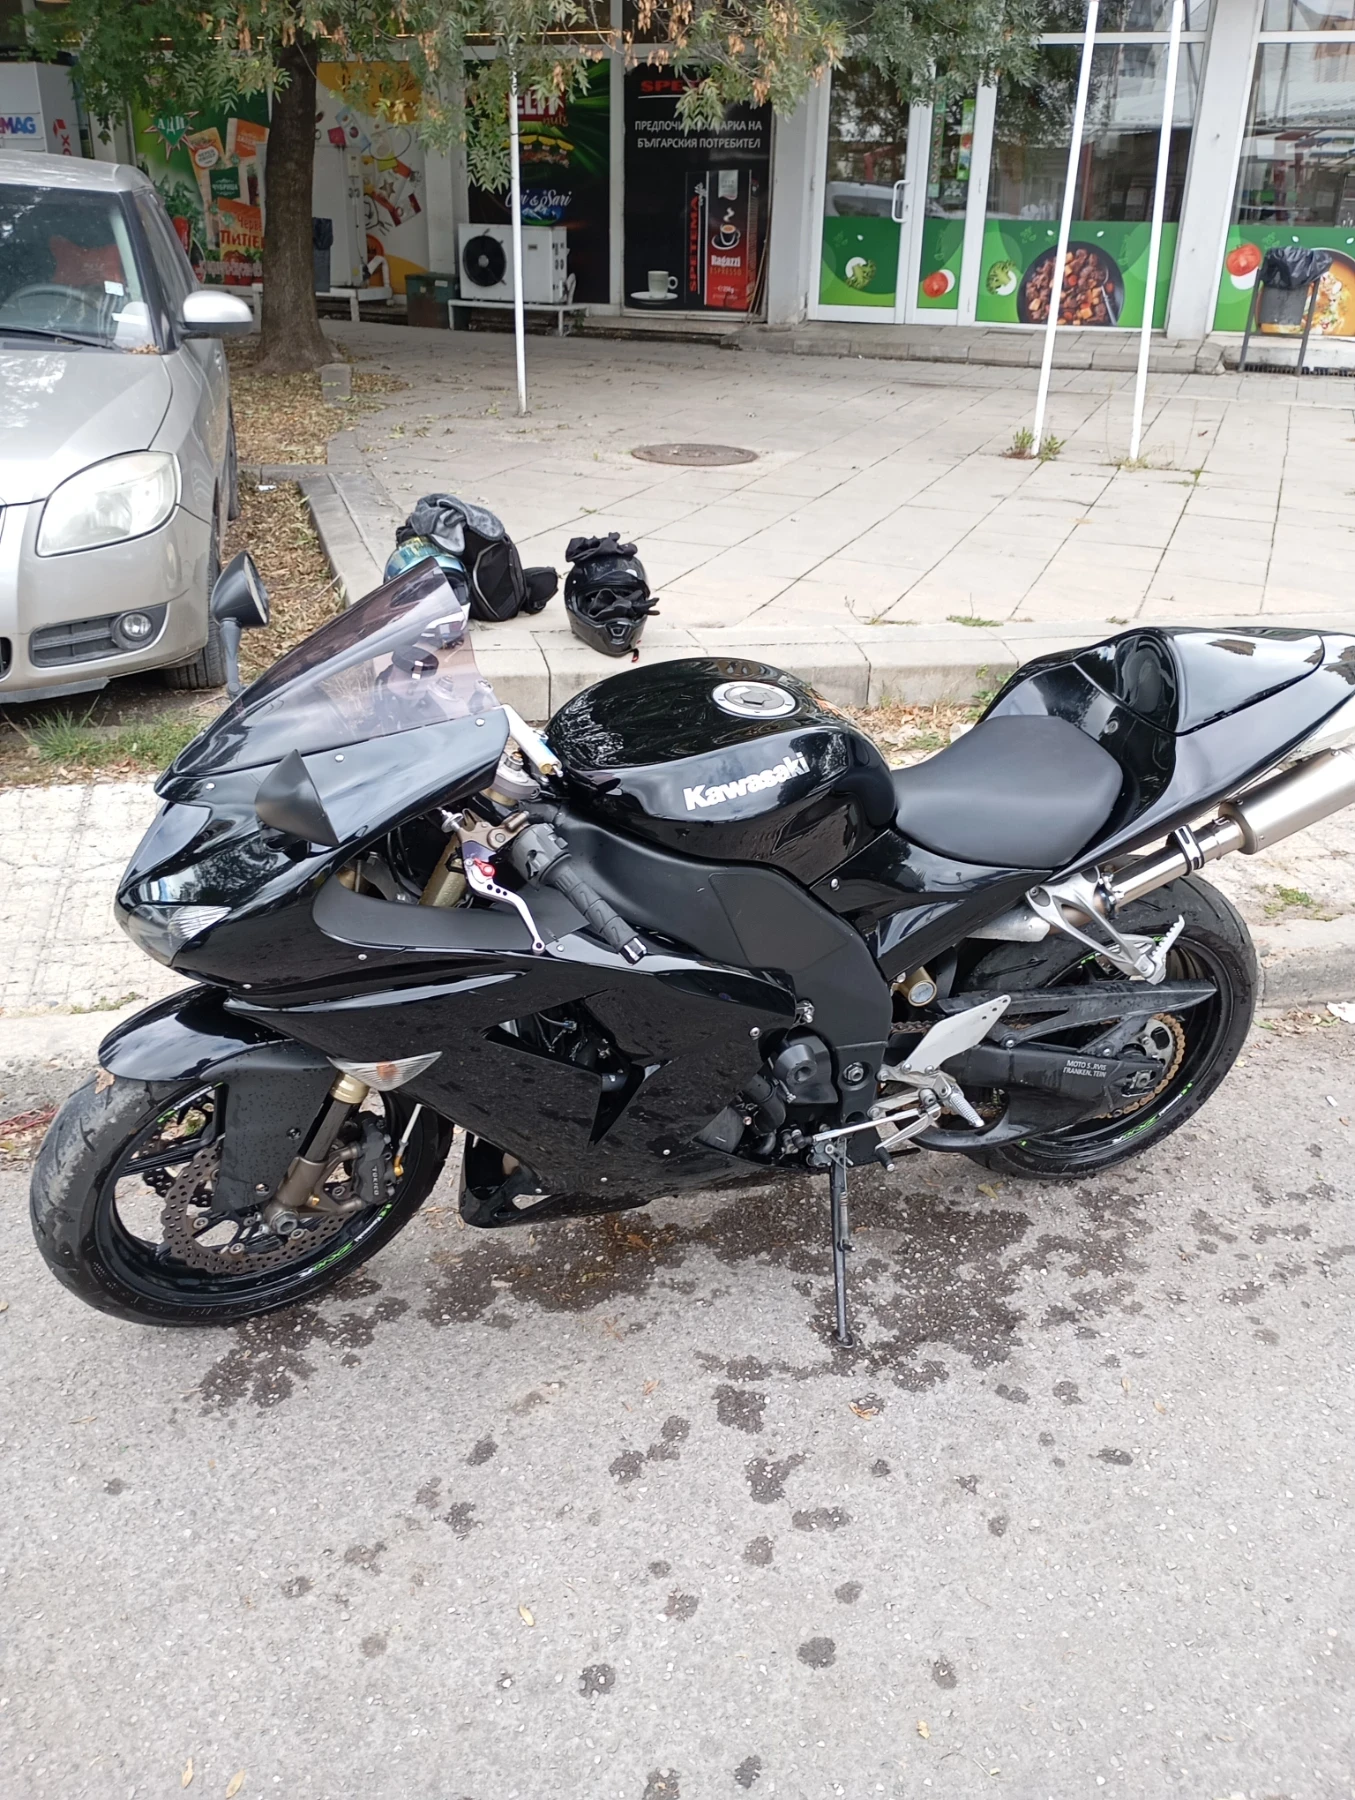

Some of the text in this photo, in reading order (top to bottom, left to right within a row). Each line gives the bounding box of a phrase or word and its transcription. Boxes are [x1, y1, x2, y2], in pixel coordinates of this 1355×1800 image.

[641, 80, 698, 92] SPE
[0, 116, 36, 134] MAG
[635, 120, 763, 132] ПРЕДПОЧАА АРКА НА
[637, 137, 761, 149] БЪЛГАРСКИЯ ПОТРЕБИТЕЛ
[505, 189, 529, 207] Oi
[237, 215, 262, 232] Черве
[711, 254, 741, 268] Ragazzi
[683, 752, 811, 811] Kawasaki
[1066, 1060, 1107, 1070] MOTO SRVIS
[1063, 1067, 1107, 1078] FRANKENTEIN
